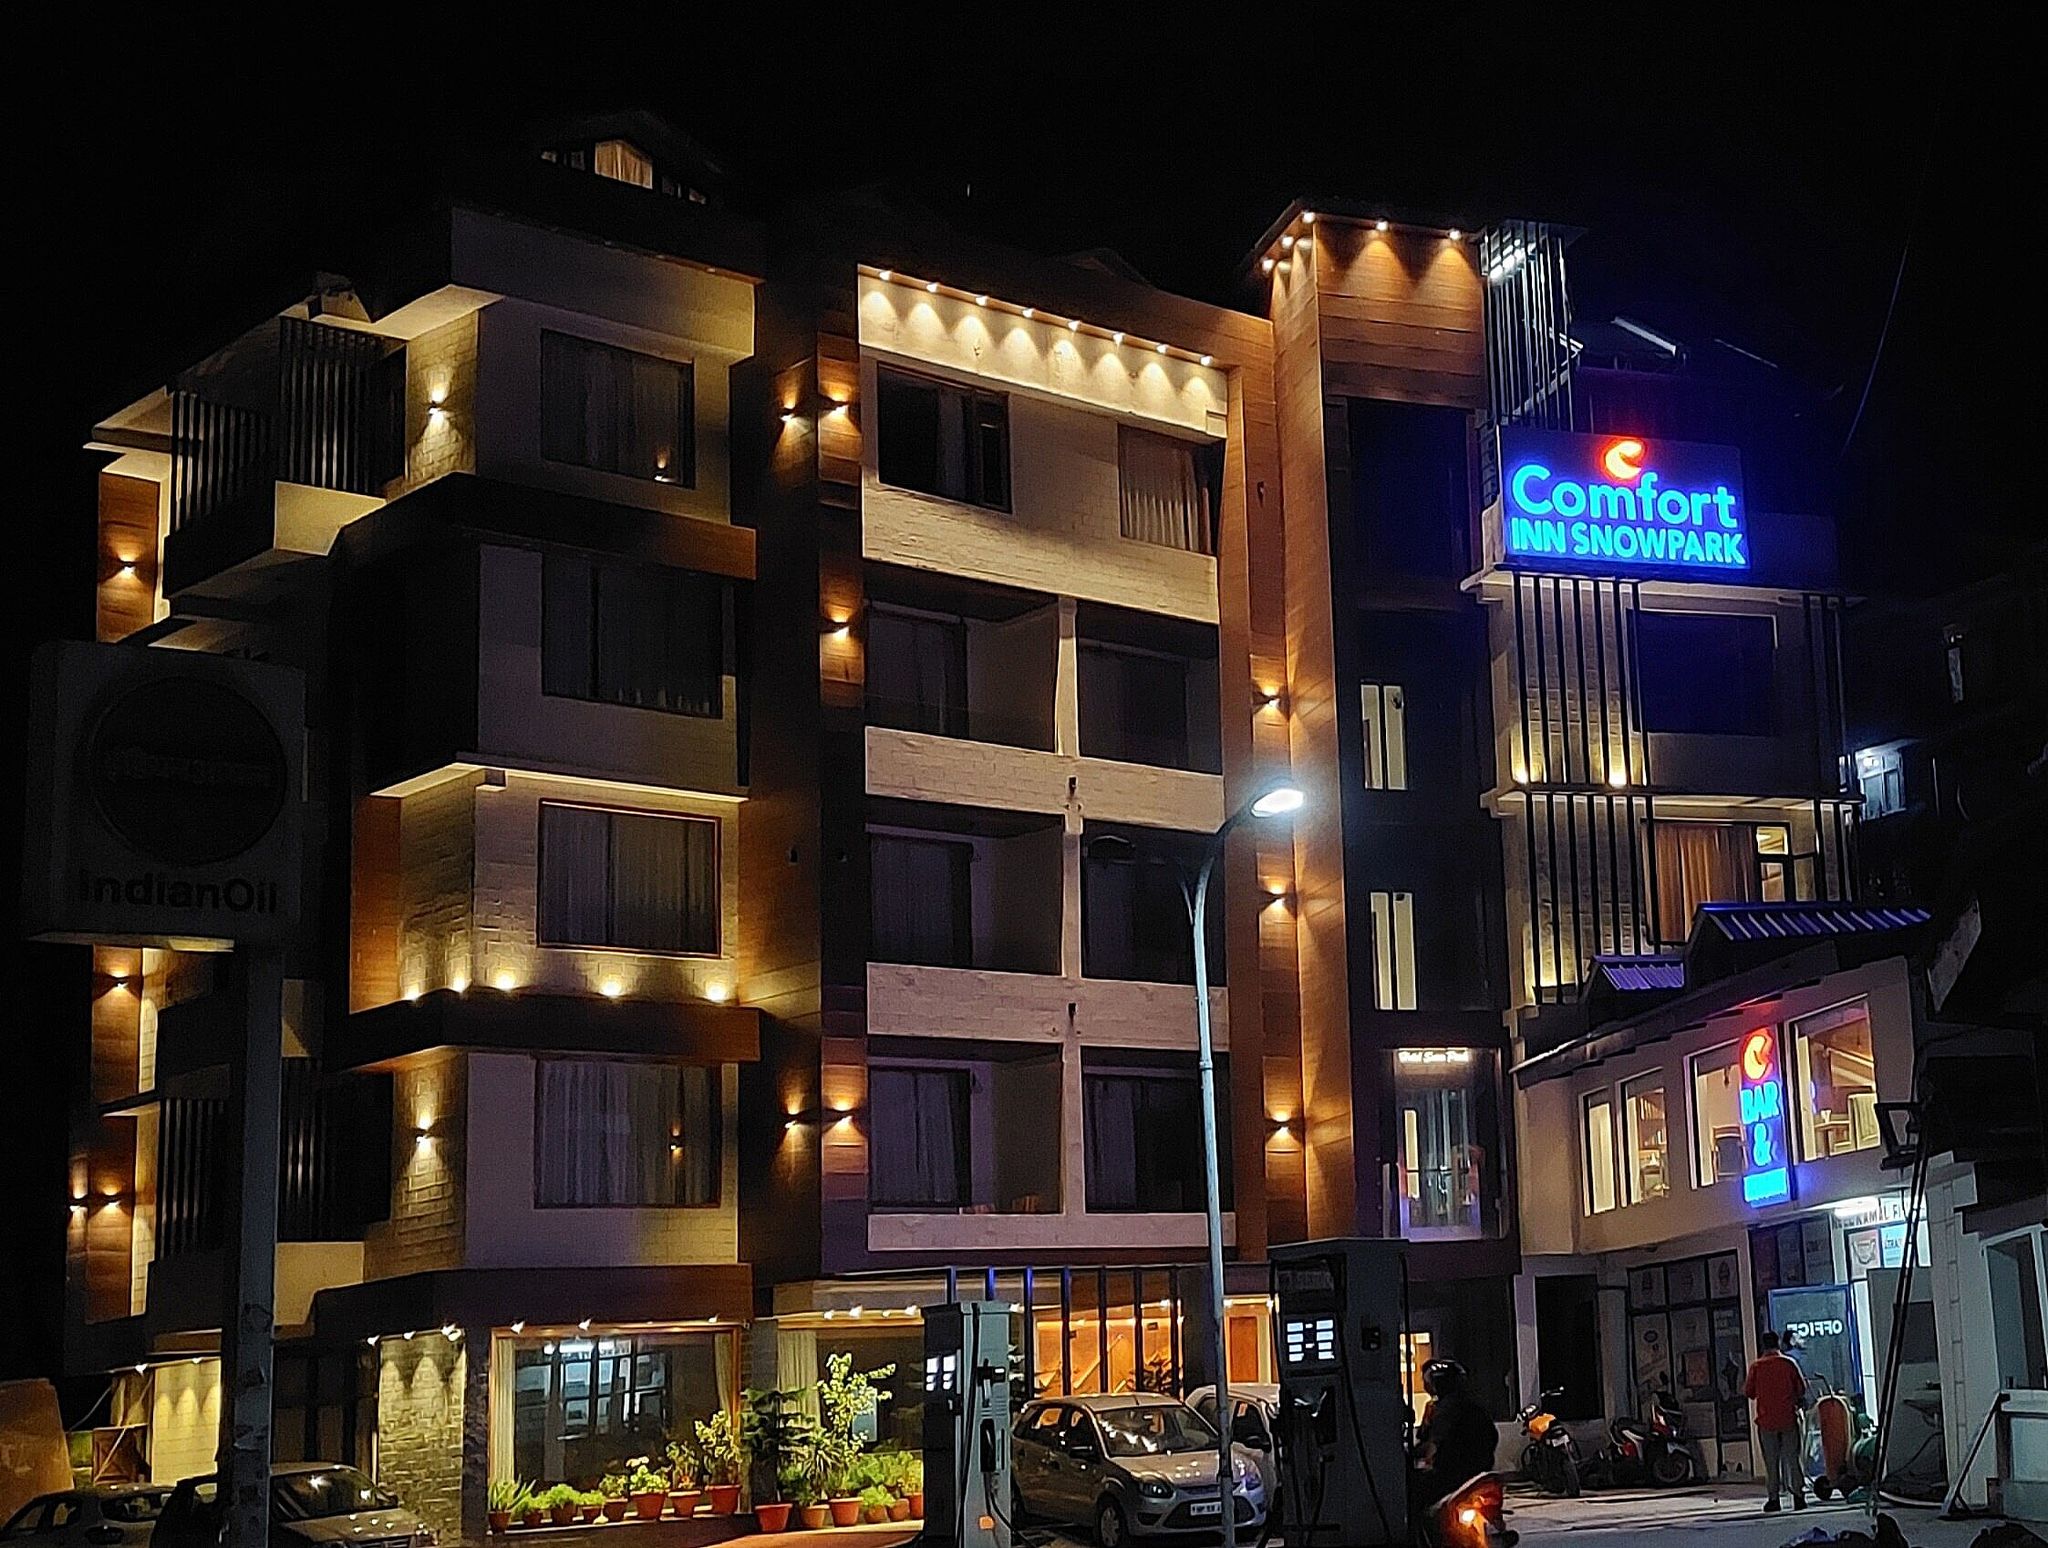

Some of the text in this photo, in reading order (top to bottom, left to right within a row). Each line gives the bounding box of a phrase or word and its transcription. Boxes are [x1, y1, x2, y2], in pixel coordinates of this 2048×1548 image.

[1511, 463, 1738, 528] Comfort
[1511, 517, 1746, 565] INN SNOWPARK
[79, 868, 278, 914] IndianOil
[1741, 1081, 1781, 1125] BAR
[1753, 1122, 1773, 1167] &
